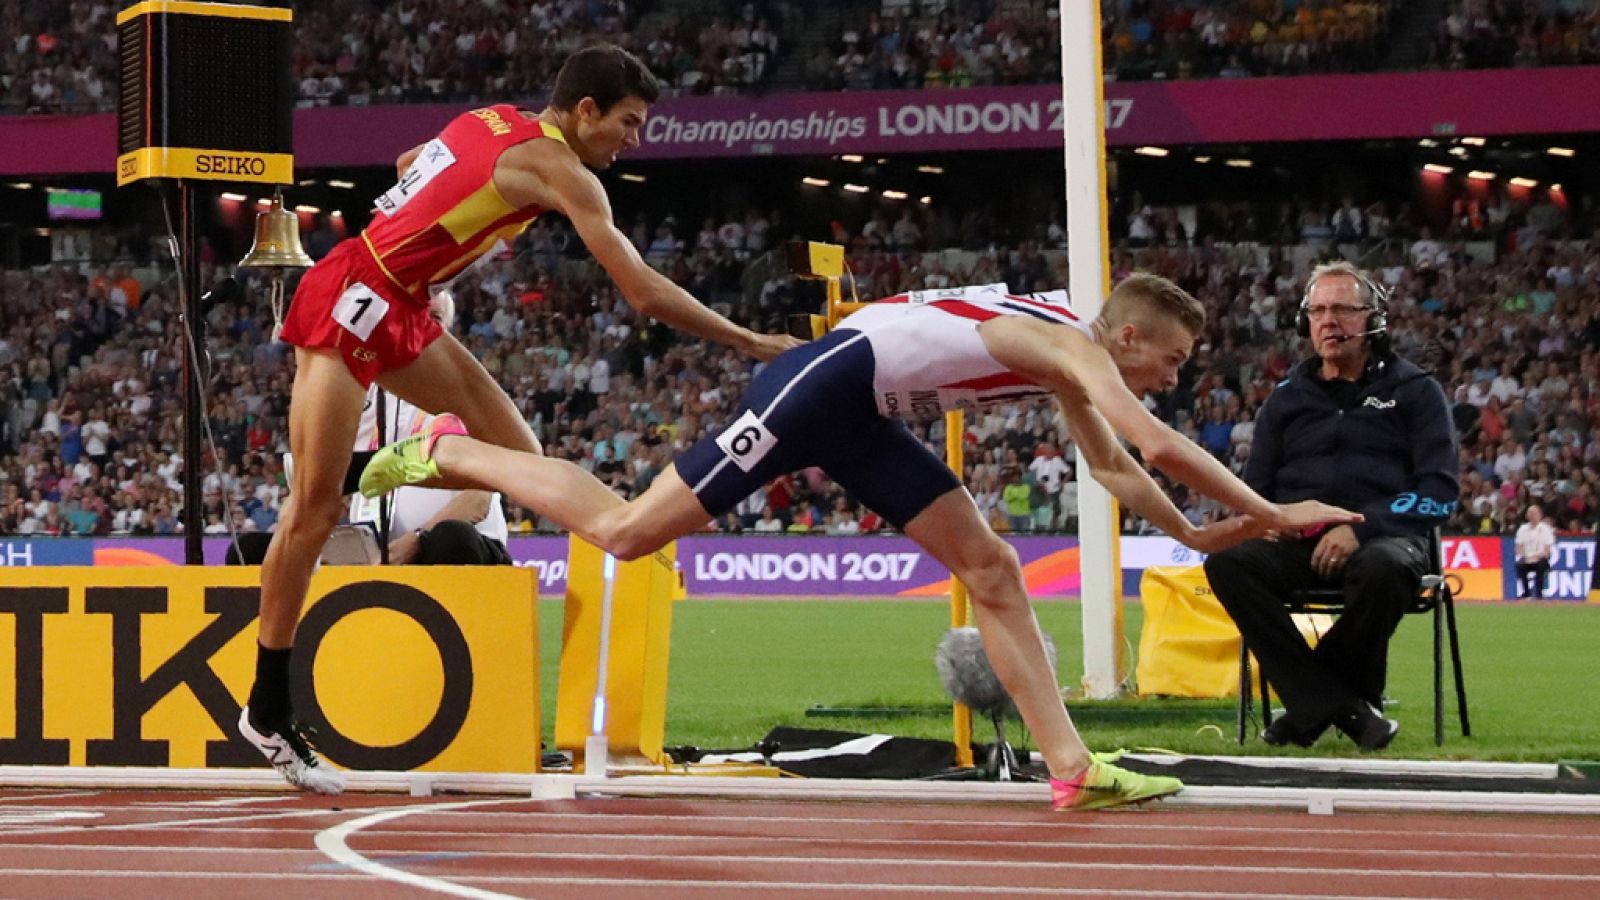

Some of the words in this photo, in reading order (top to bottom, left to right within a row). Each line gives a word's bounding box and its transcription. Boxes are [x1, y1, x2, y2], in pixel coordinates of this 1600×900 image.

[645, 111, 867, 148] Championships
[878, 102, 1041, 136] LONDON
[1046, 99, 1134, 131] 217
[196, 154, 266, 176] SEIKO
[349, 296, 373, 326] 1
[730, 425, 762, 456] 6
[694, 552, 838, 582] LONDON
[840, 552, 921, 582] 2017
